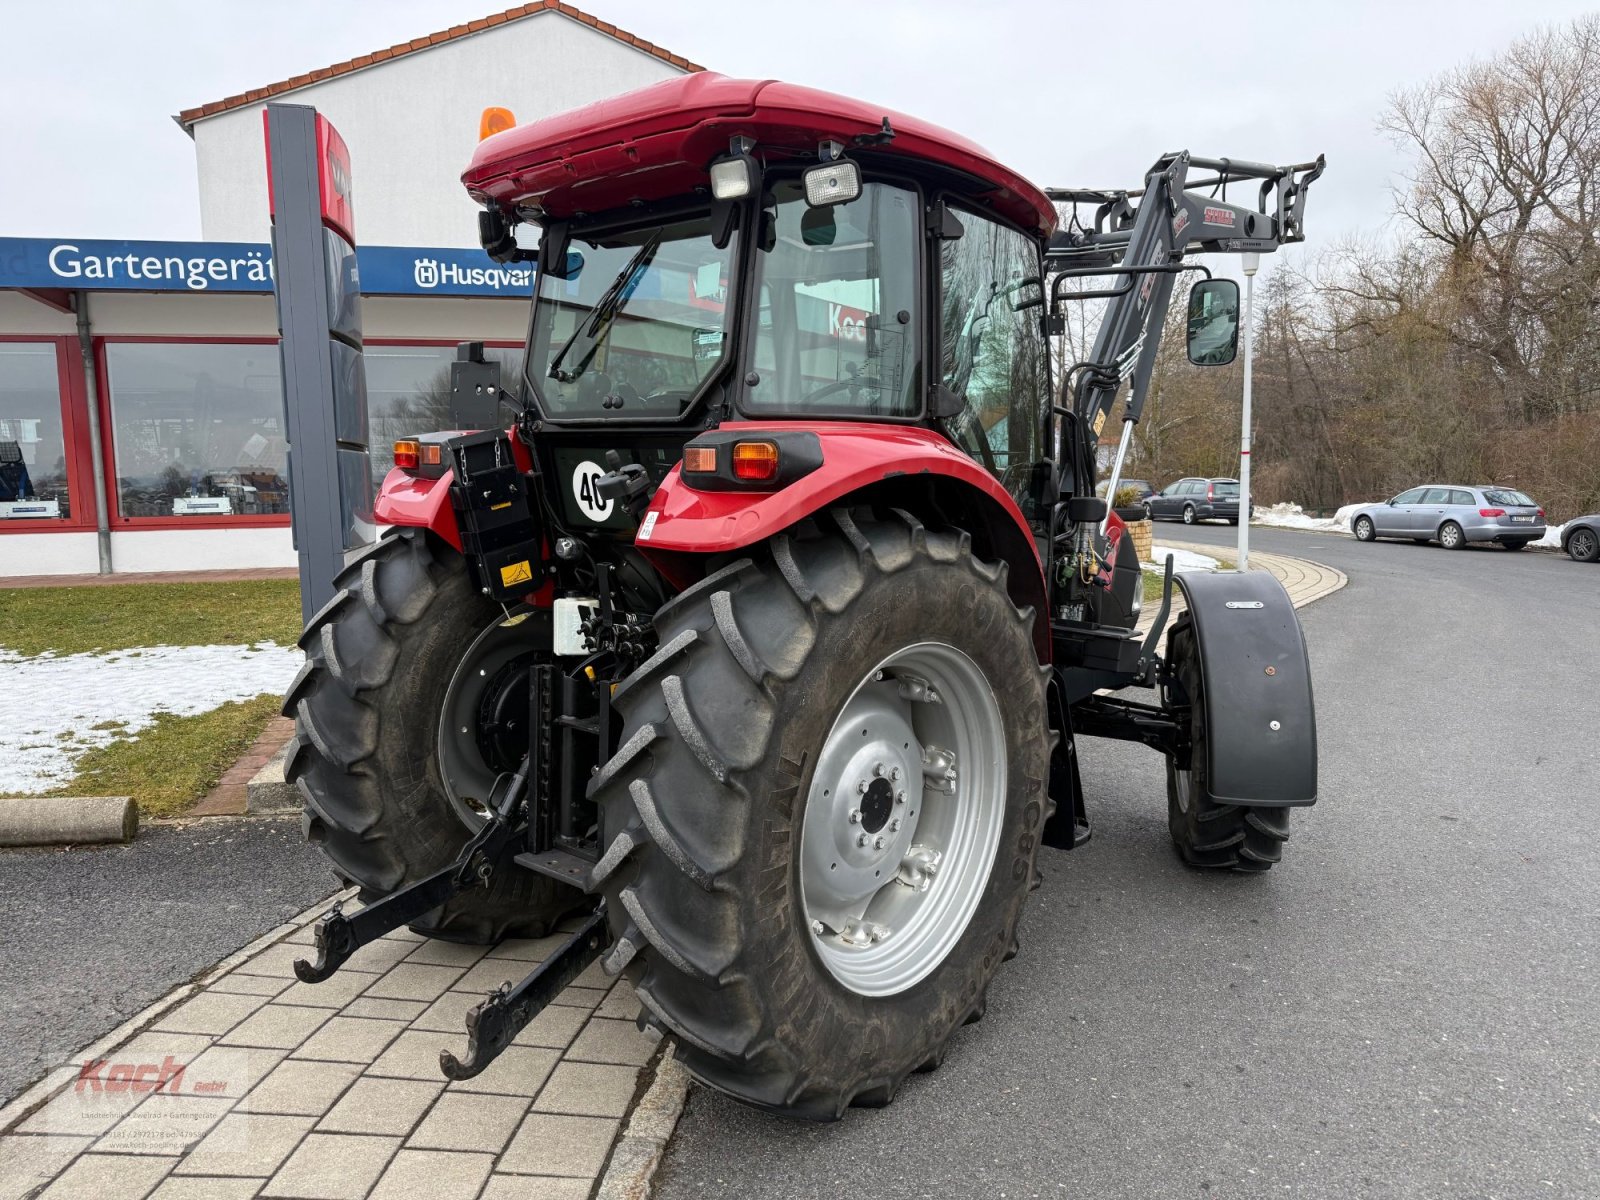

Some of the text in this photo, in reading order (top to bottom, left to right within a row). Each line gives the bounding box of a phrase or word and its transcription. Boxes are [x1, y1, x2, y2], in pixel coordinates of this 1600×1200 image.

[440, 262, 537, 290] Husqvar
[828, 302, 870, 341] Koc
[580, 472, 607, 512] 40
